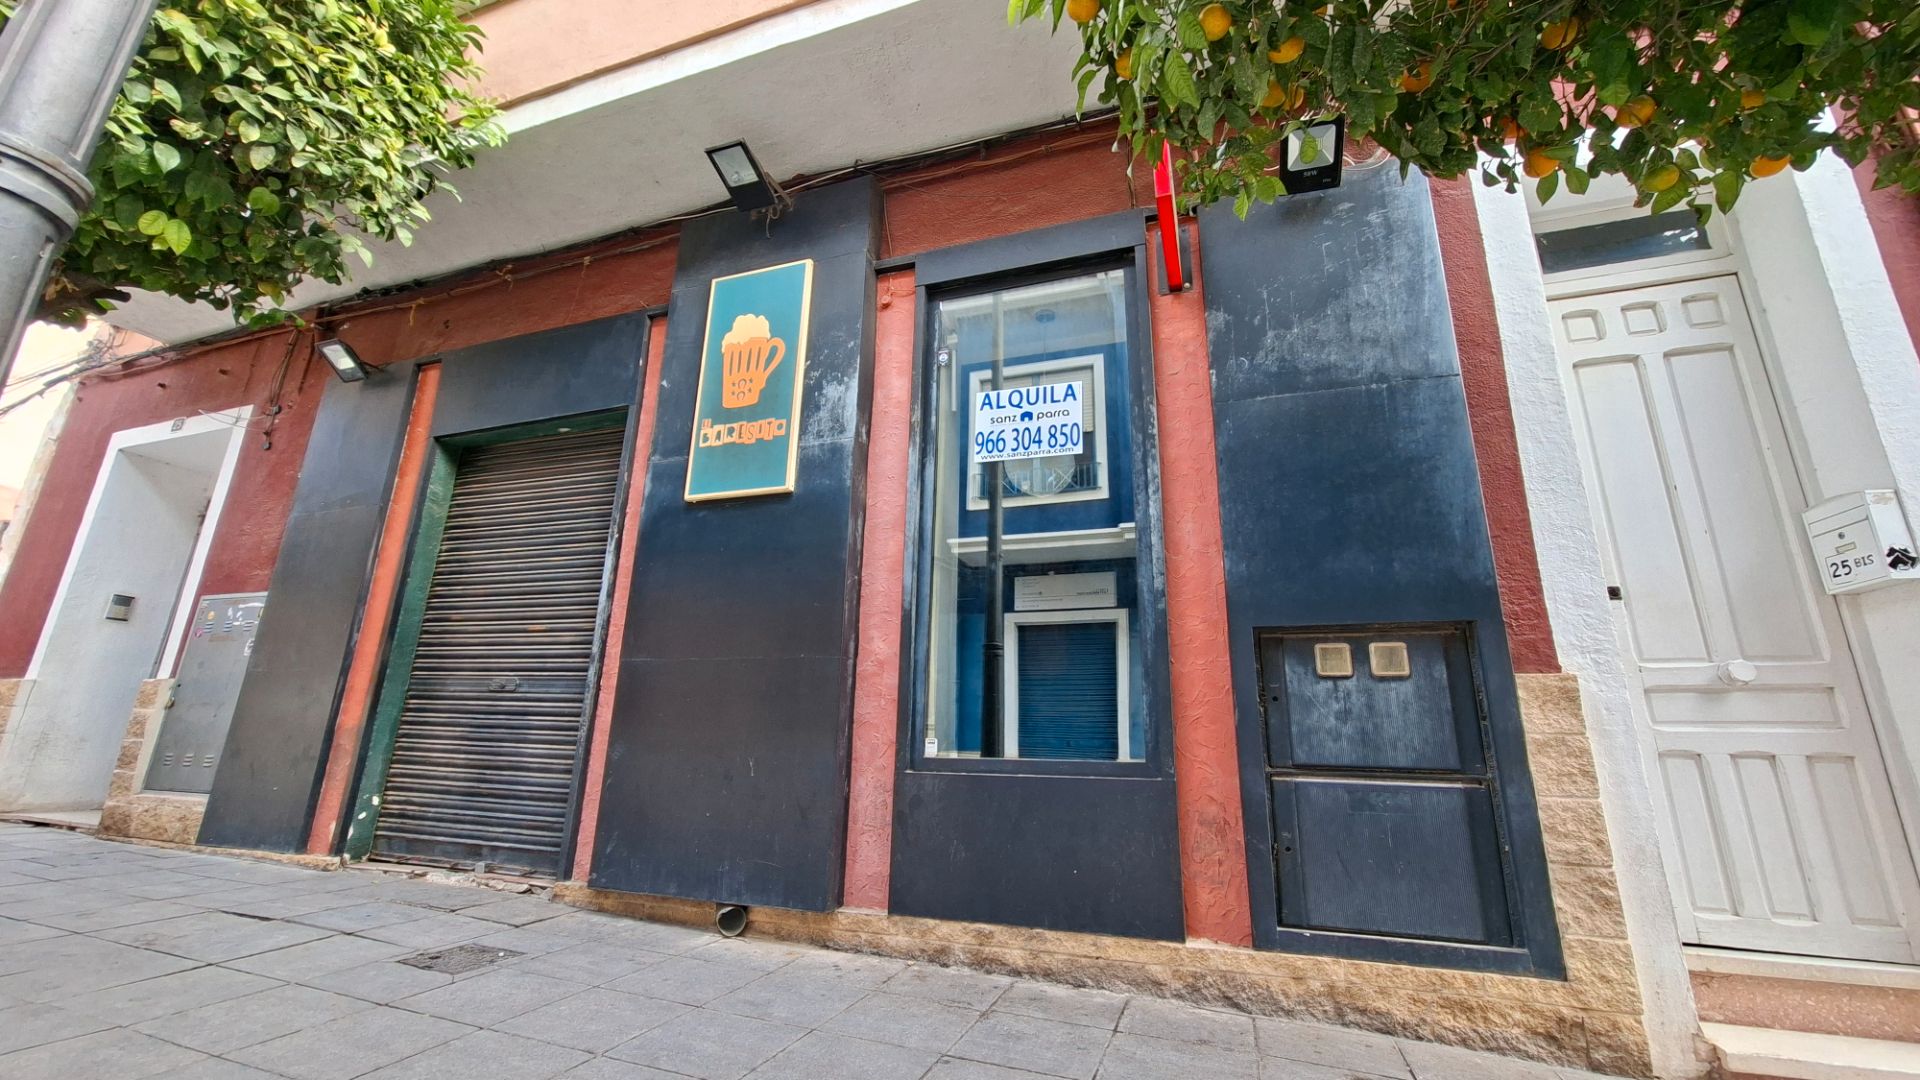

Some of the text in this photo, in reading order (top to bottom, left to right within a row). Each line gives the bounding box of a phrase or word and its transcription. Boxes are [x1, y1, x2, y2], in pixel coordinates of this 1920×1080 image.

[980, 384, 1077, 411] ALQUILA
[990, 409, 1070, 424] sanz parra
[701, 420, 785, 445] BARESITO
[975, 422, 1080, 455] 966 304 850
[981, 447, 1074, 460] www.sanzparra.com
[1830, 554, 1874, 578] 25 BIS
